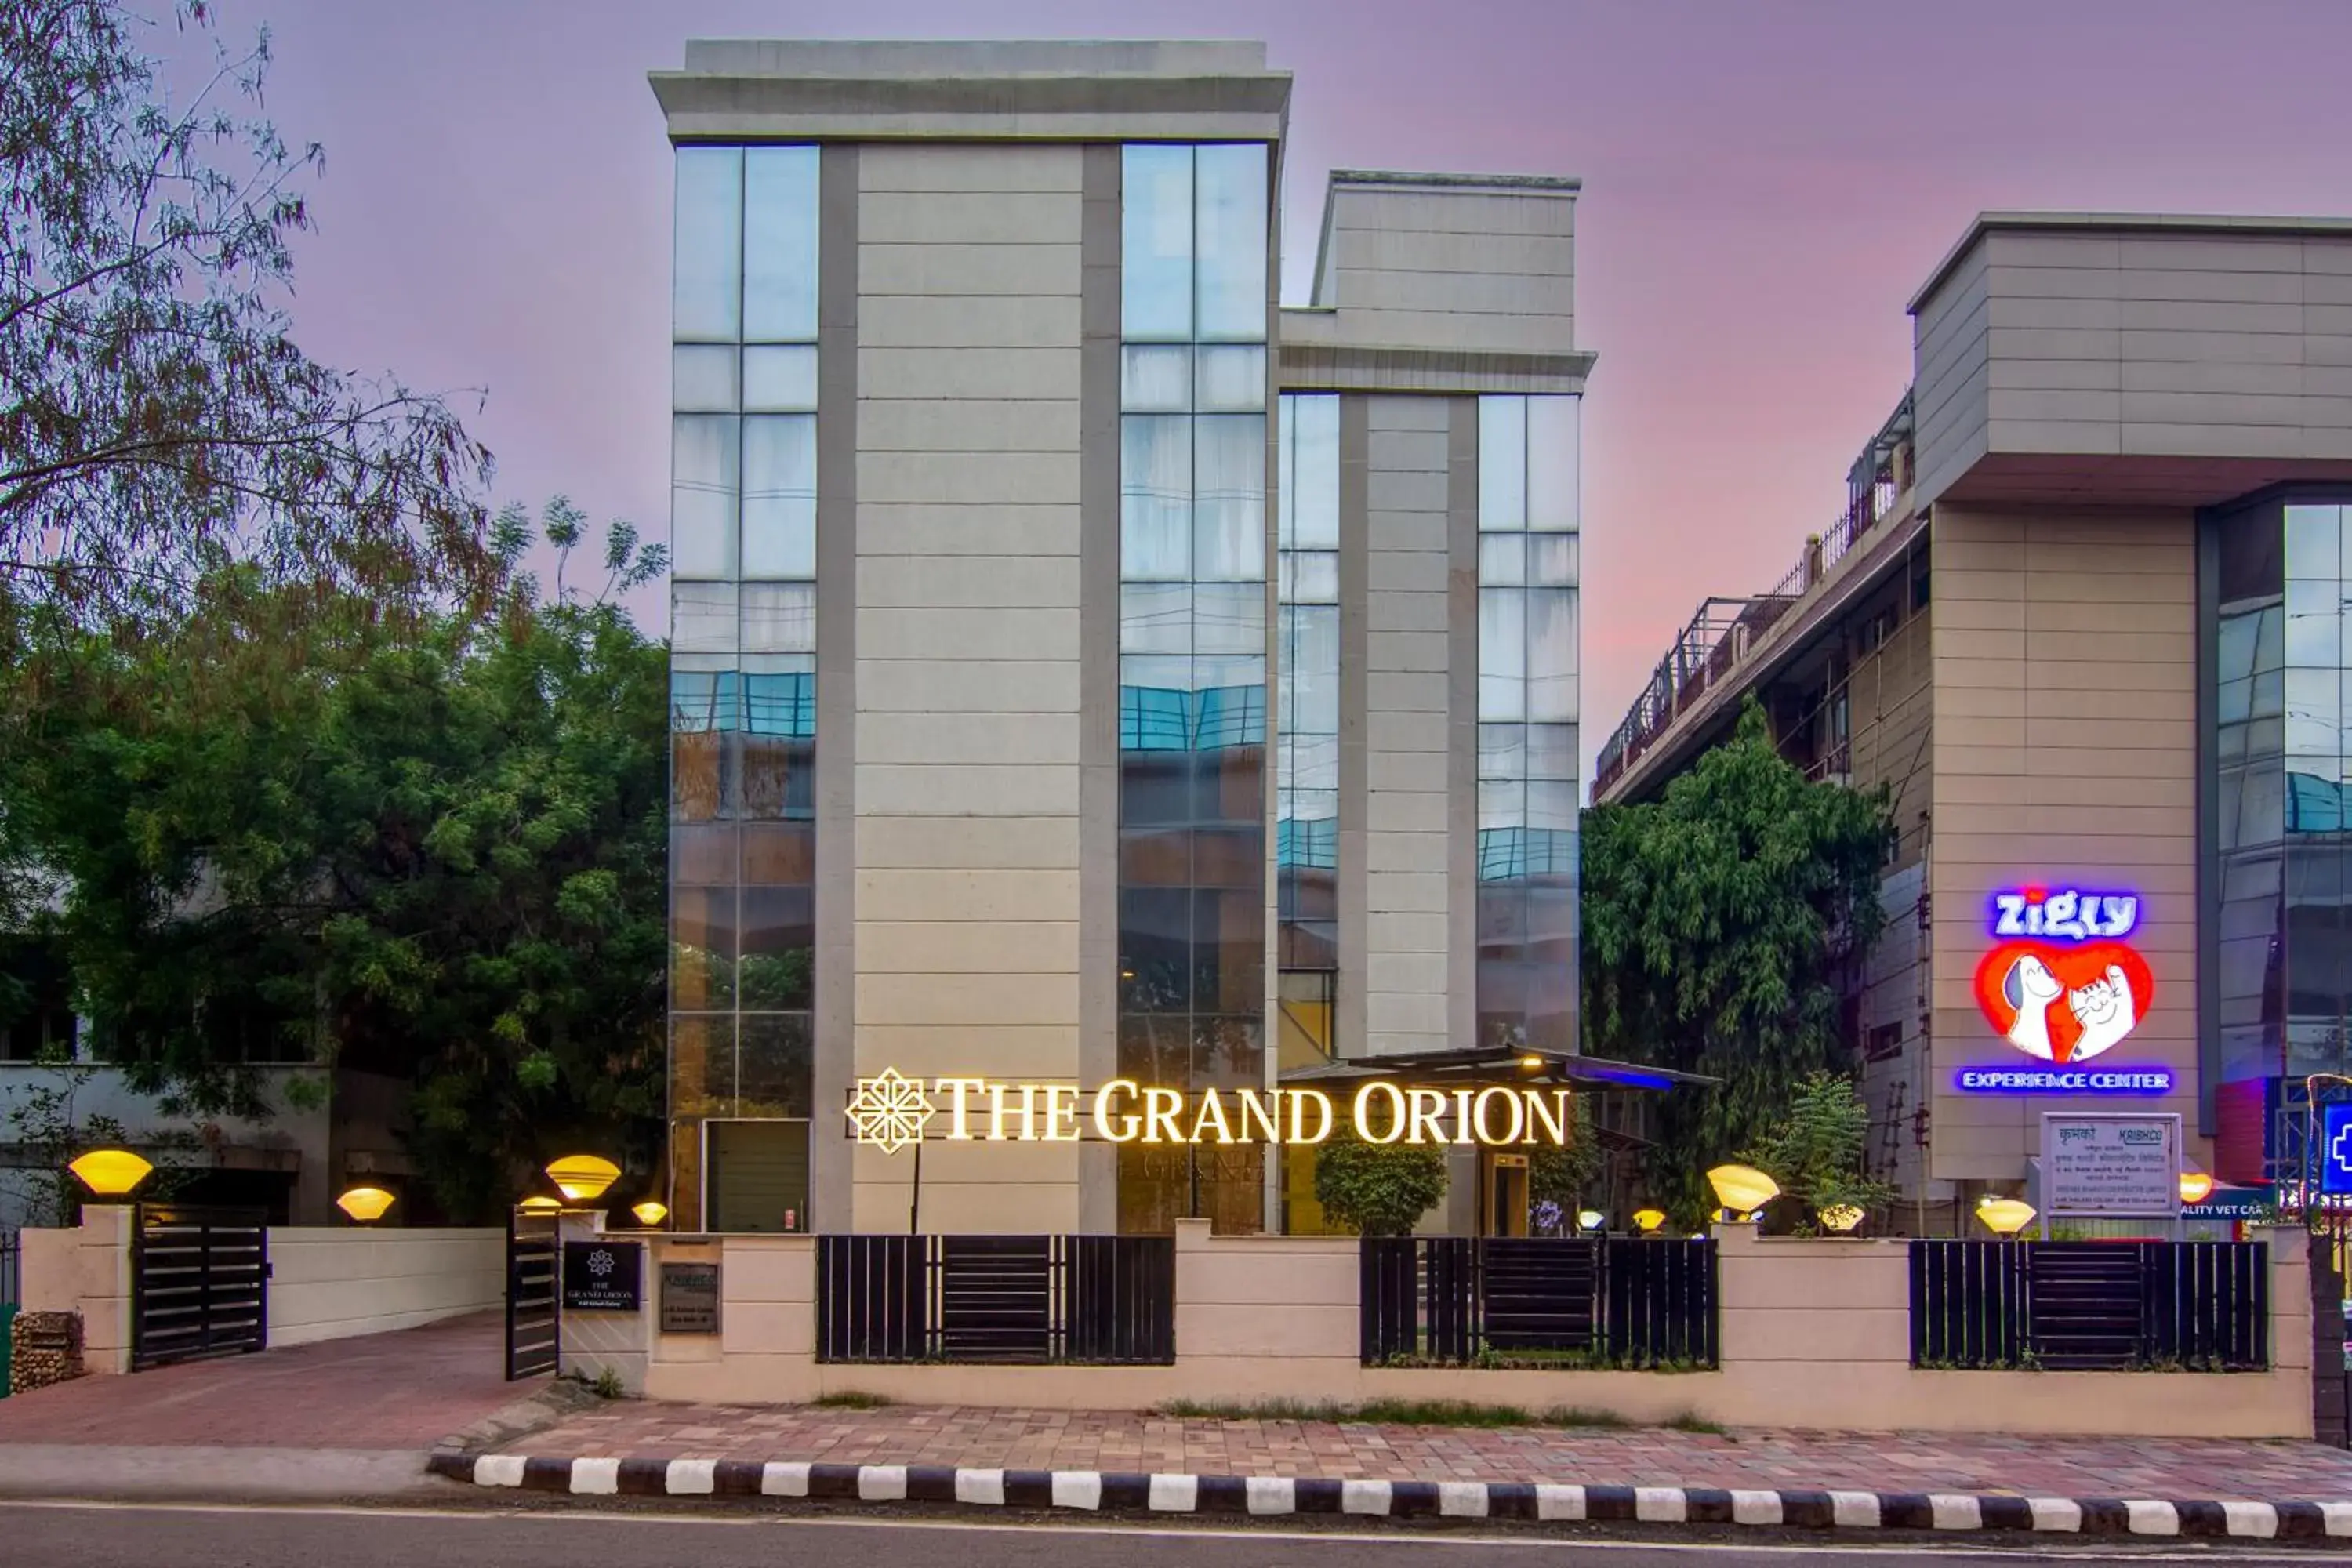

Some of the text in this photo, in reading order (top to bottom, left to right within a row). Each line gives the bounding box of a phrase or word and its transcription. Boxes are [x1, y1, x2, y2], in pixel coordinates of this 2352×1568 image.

[1963, 1073, 2169, 1088] EXPERIENCE CENTER
[934, 1078, 1570, 1145] THE GRAND ORION
[2181, 1205, 2263, 1215] ALITY VET CAR
